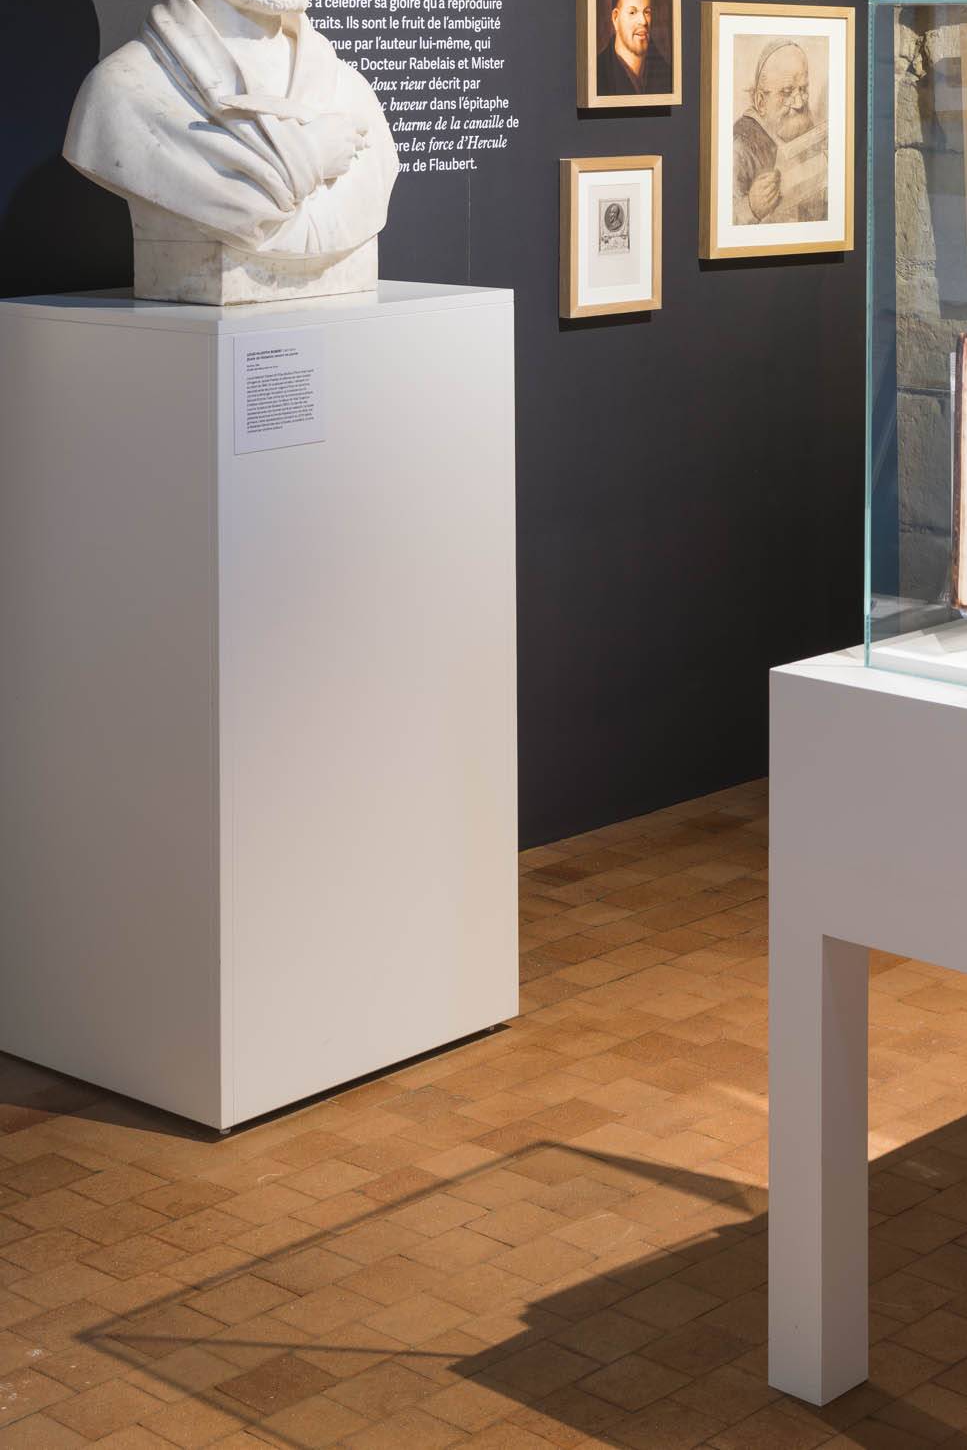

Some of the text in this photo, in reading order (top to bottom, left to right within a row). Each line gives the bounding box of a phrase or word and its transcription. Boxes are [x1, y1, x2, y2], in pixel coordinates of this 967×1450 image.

[374, 0, 387, 8] sa
[347, 16, 359, 29] Ils
[362, 17, 387, 29] sont
[389, 16, 399, 29] le
[401, 16, 425, 29] fruit
[427, 16, 441, 29] de
[444, 16, 500, 32] l'ambigüité
[355, 40, 373, 53] par
[376, 36, 417, 49] l'auteur
[419, 36, 472, 51] lui-même,
[475, 36, 490, 52] qui
[361, 58, 407, 70] Docteur
[409, 57, 455, 70] Rabelais
[458, 58, 469, 69] et
[472, 57, 504, 69] Mister
[400, 76, 426, 90] rieur
[428, 77, 461, 90] décrit
[463, 80, 481, 92] par
[390, 97, 428, 111] buveur
[430, 97, 456, 110] dans
[459, 96, 509, 112] l'épitaphe
[392, 115, 519, 132] charme de la canaille de
[411, 138, 426, 151] les
[428, 137, 454, 153] force
[457, 134, 507, 149] d'Hercule
[413, 159, 427, 172] de
[429, 157, 477, 171] Flaubert.
